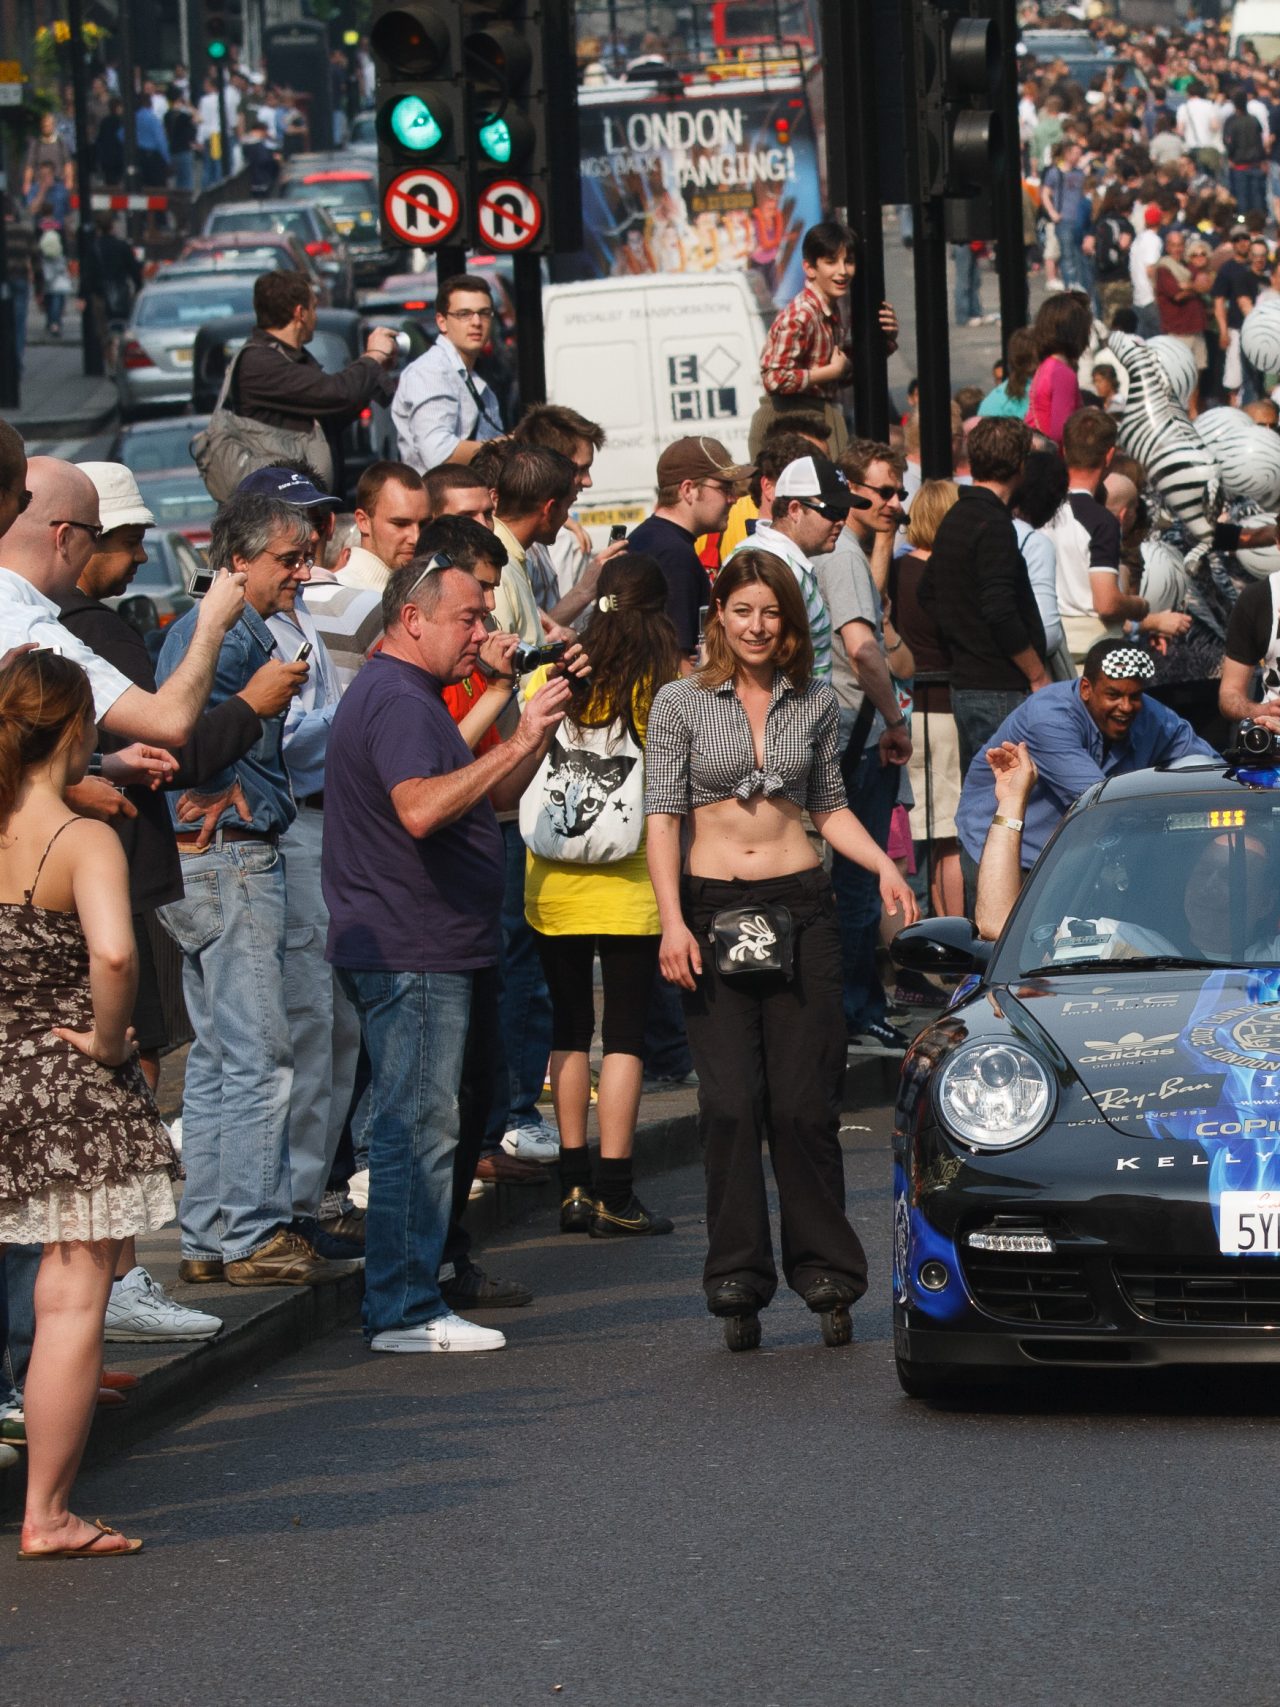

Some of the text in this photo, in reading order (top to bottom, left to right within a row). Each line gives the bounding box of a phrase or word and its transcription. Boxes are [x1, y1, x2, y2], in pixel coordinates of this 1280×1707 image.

[603, 107, 743, 154] LONDON
[661, 146, 796, 190] HANGING!
[564, 302, 732, 325] SPECIALIST TRANSPORTATION
[1078, 1048, 1175, 1064] adidas
[1092, 1058, 1157, 1069] ORIGINALS
[1082, 1076, 1213, 1112] Ray-Ban
[1136, 1111, 1177, 1120] SINCE
